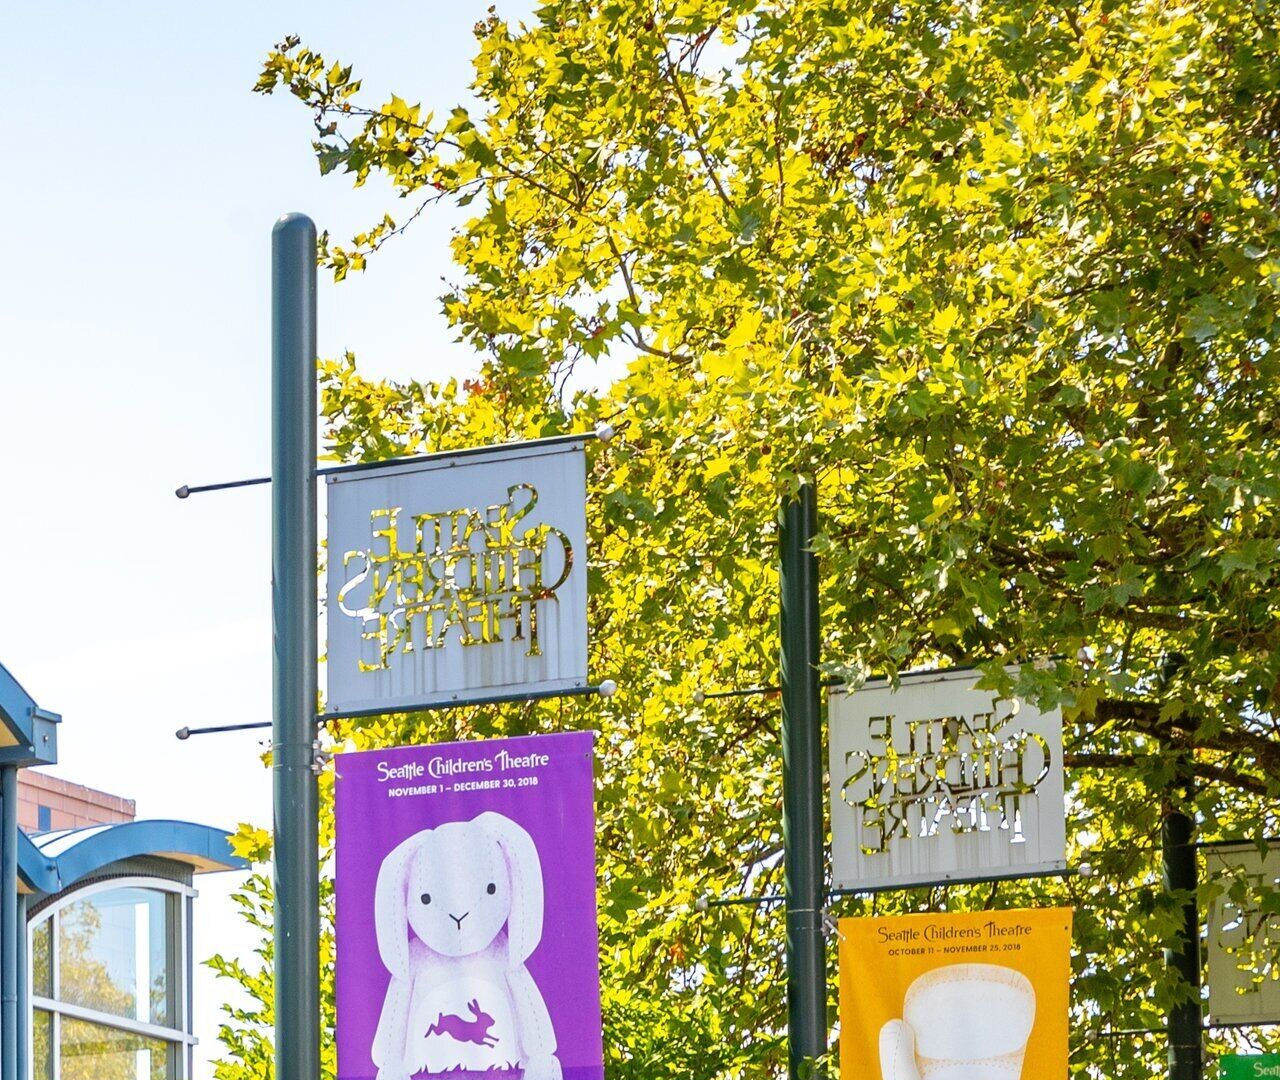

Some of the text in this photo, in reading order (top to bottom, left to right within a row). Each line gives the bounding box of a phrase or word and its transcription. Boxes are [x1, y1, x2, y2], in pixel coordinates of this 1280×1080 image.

[377, 749, 549, 782] Seattle Children's Theatre
[388, 785, 437, 797] NOVEMBER
[454, 780, 501, 791] DECEMBER
[518, 777, 538, 786] 2018
[877, 920, 1032, 944] Seattle Children's Theatre
[888, 947, 926, 956] OCTOBER
[943, 945, 987, 954] NOVEMBER
